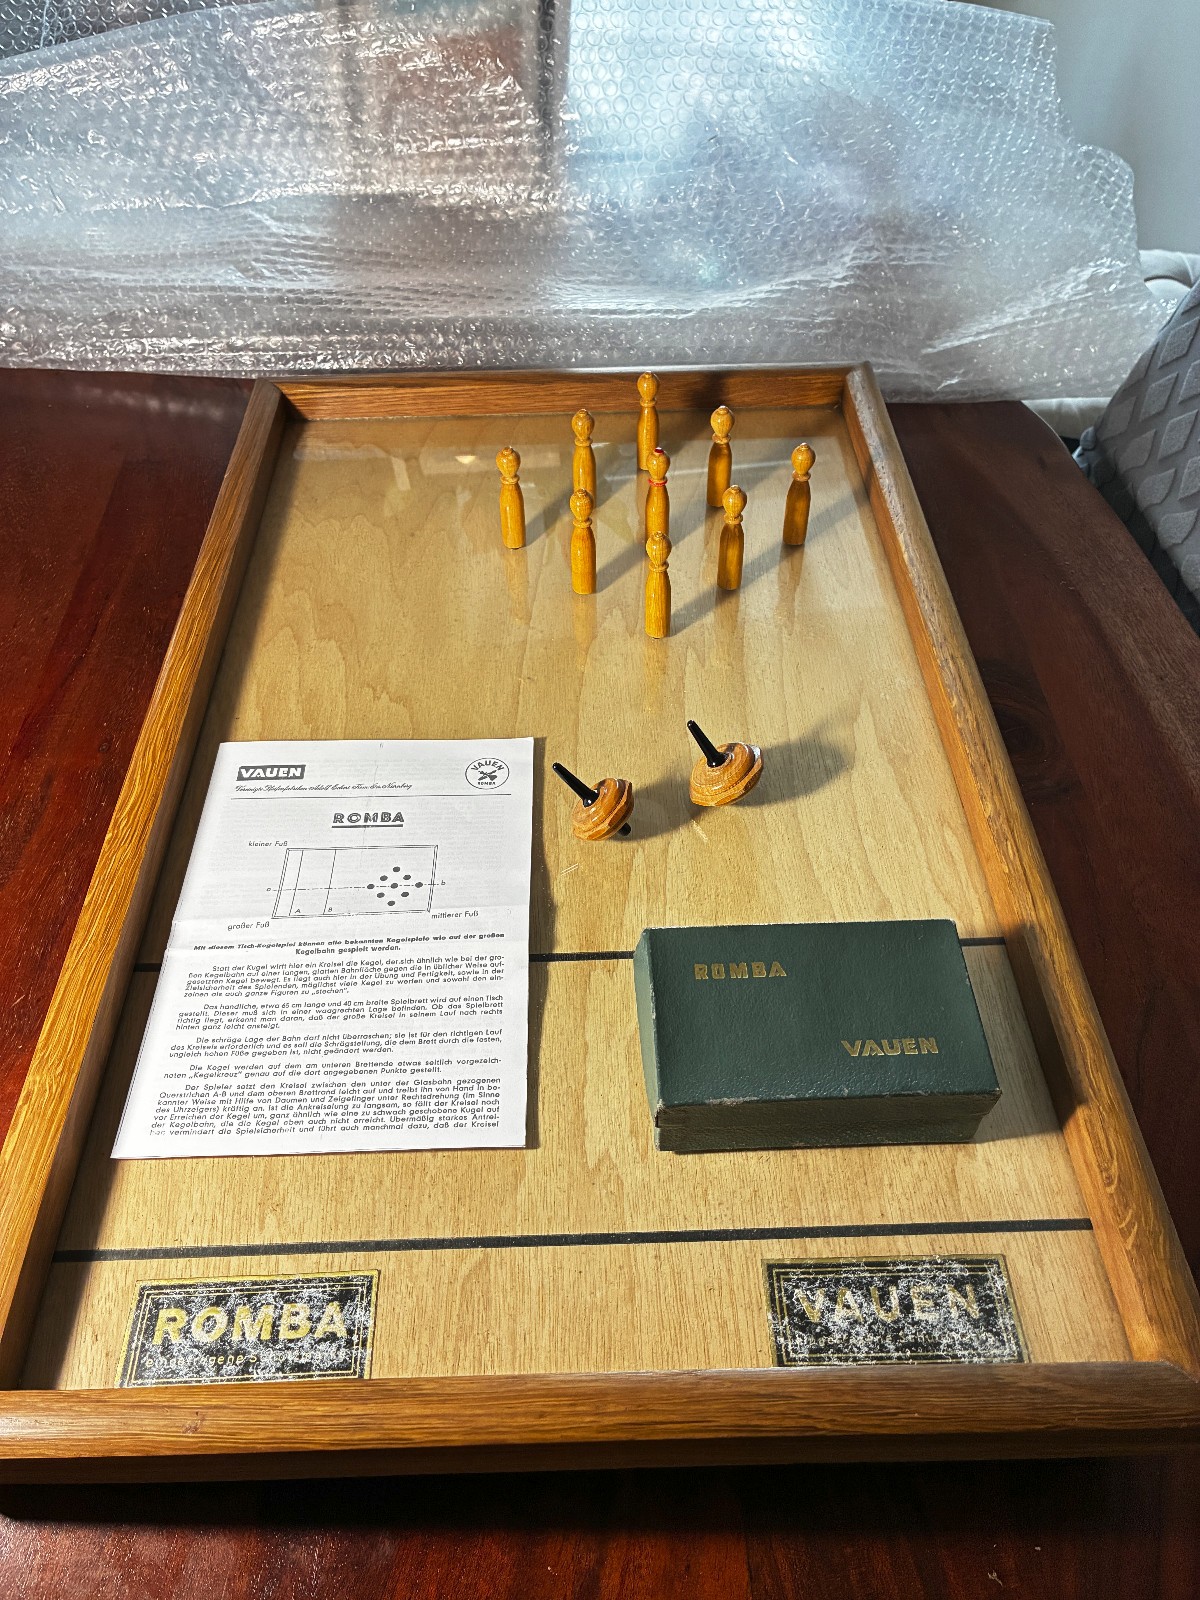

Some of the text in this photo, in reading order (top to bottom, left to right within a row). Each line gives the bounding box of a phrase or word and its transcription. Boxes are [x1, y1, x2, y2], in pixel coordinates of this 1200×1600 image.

[471, 760, 504, 770] VAUEN
[239, 766, 303, 779] VAUEN
[333, 811, 404, 823] ROMBA
[431, 912, 462, 920] mittlerer
[227, 921, 270, 931] großer Fuß
[694, 961, 787, 980] ROMBA
[841, 1037, 939, 1057] VAUEN
[793, 1283, 980, 1323] VAUEN
[152, 1301, 348, 1345] ROMBA
